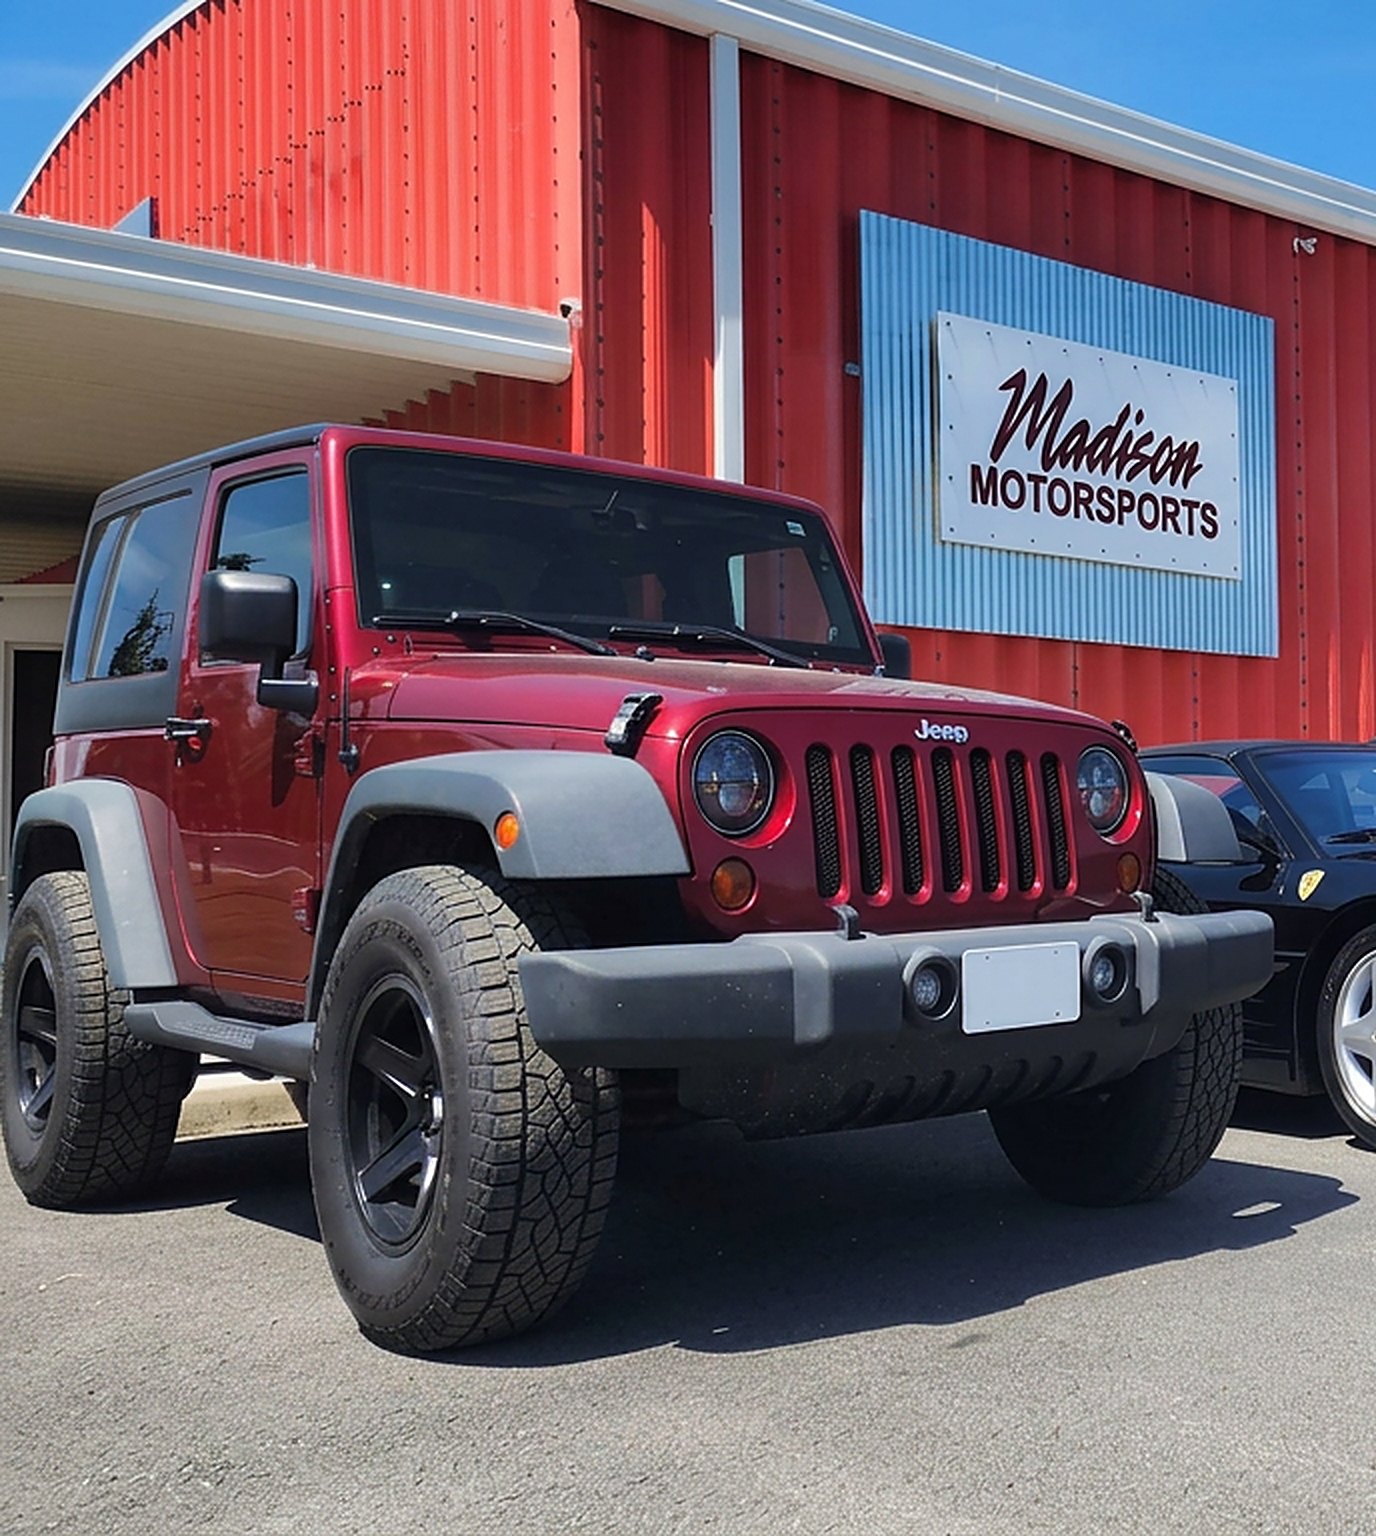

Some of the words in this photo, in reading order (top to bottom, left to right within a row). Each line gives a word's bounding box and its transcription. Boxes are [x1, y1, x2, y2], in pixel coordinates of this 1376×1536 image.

[989, 368, 1203, 490] Madison
[970, 463, 1219, 540] MOTORSPORTS
[914, 719, 969, 744] Jeep
